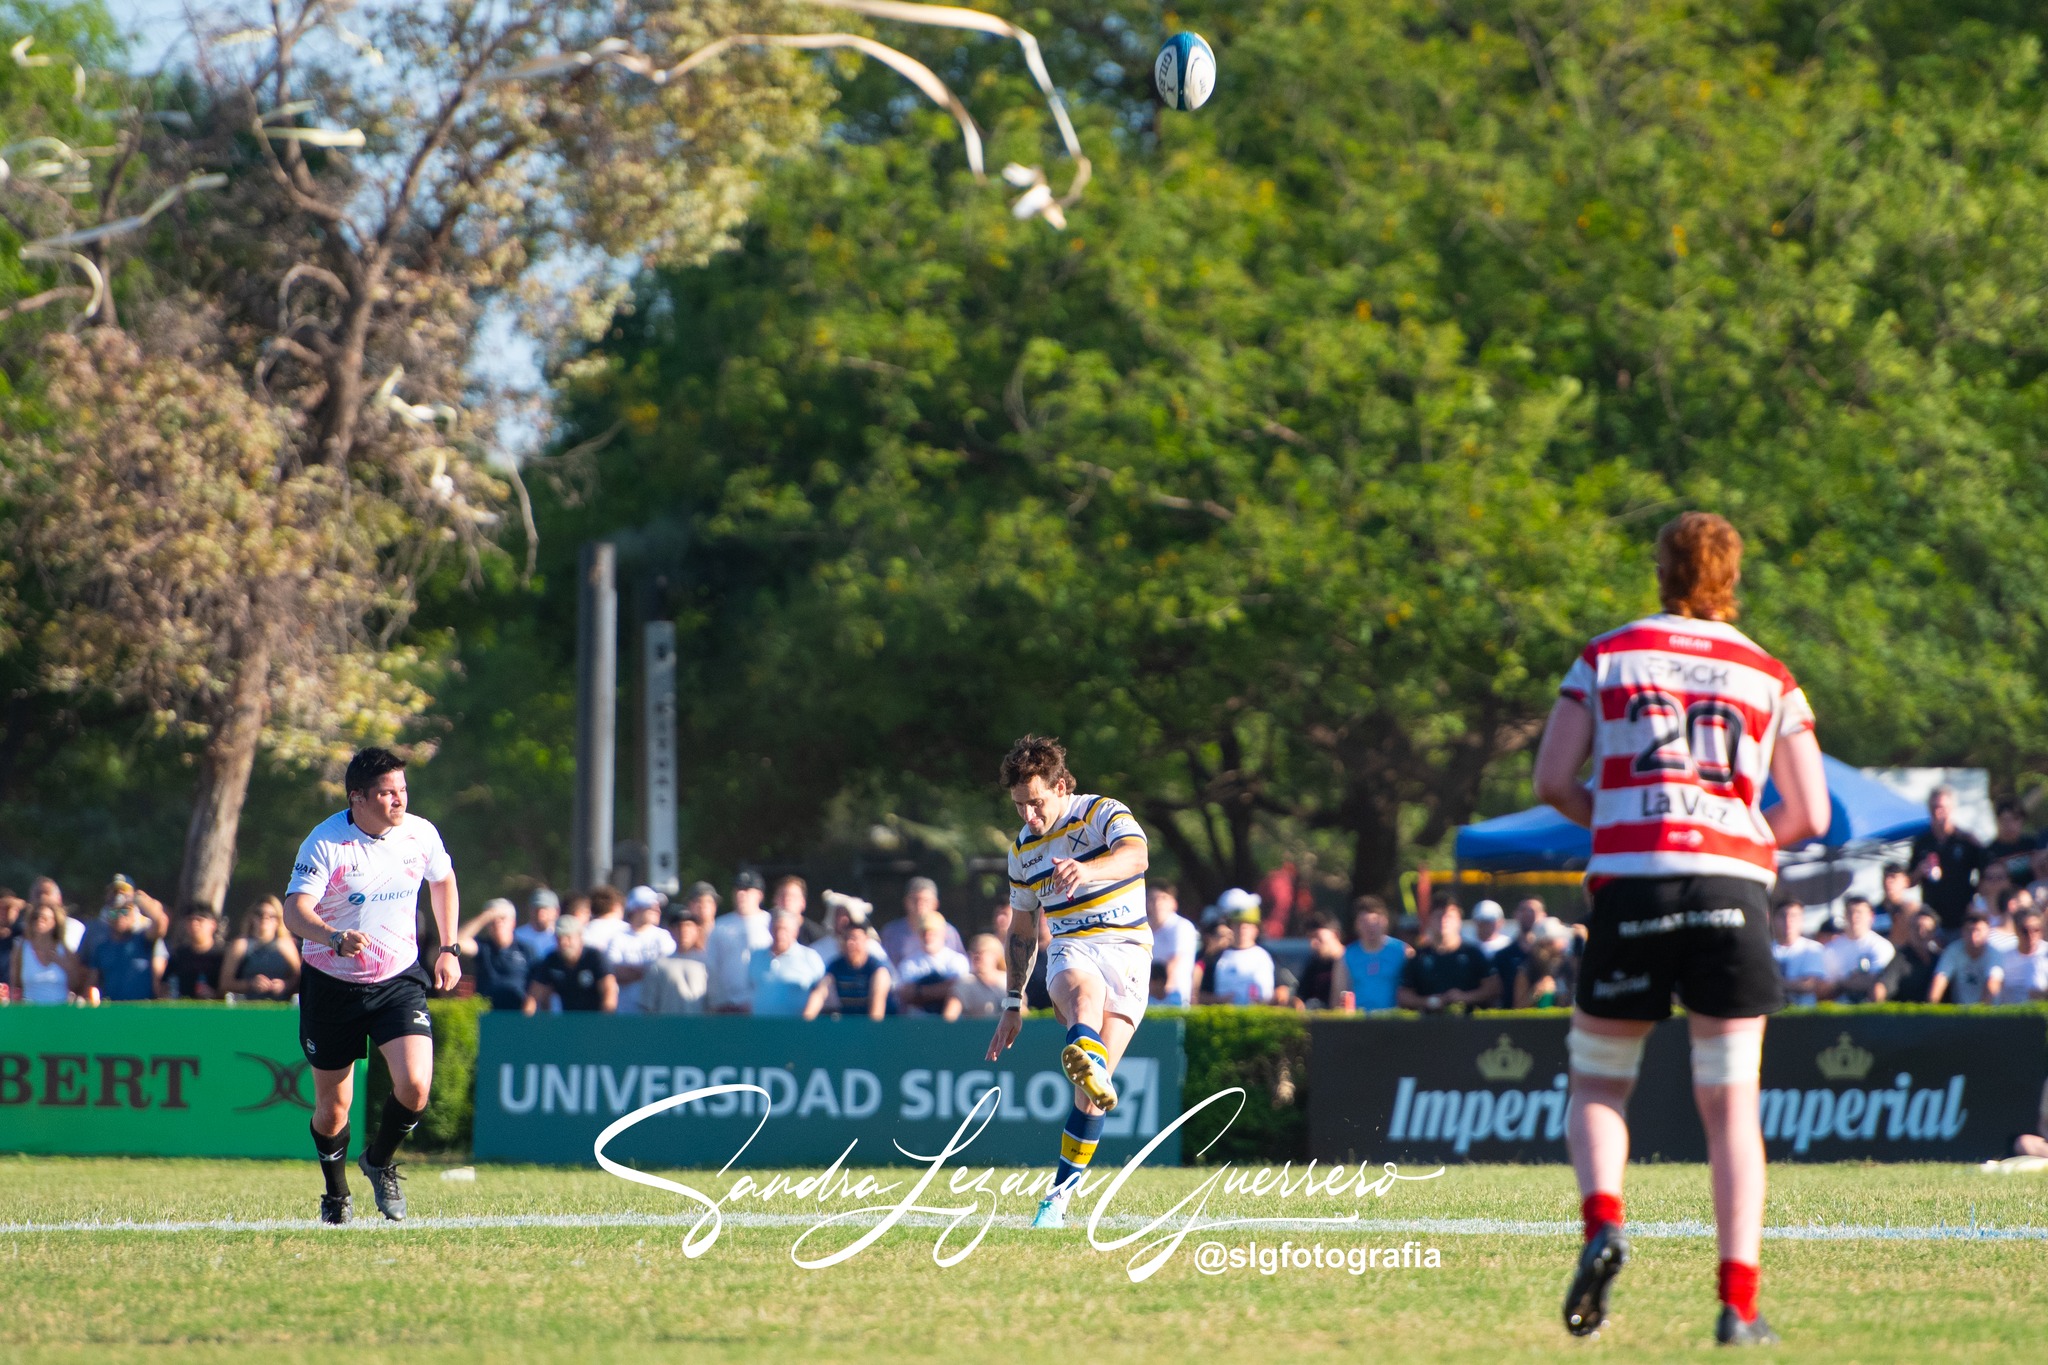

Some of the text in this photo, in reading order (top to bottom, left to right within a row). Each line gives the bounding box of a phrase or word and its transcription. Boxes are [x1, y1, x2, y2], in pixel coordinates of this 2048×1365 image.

[1626, 690, 1744, 784] 20
[1642, 788, 1672, 816] La
[371, 888, 414, 902] ZURICH
[0, 1053, 198, 1110] BERT
[501, 1063, 883, 1118] UNIVERSIDAD
[901, 1068, 1072, 1121] SIGLO
[1388, 1074, 1569, 1154] Imperi
[1759, 1072, 1967, 1153] mperial
